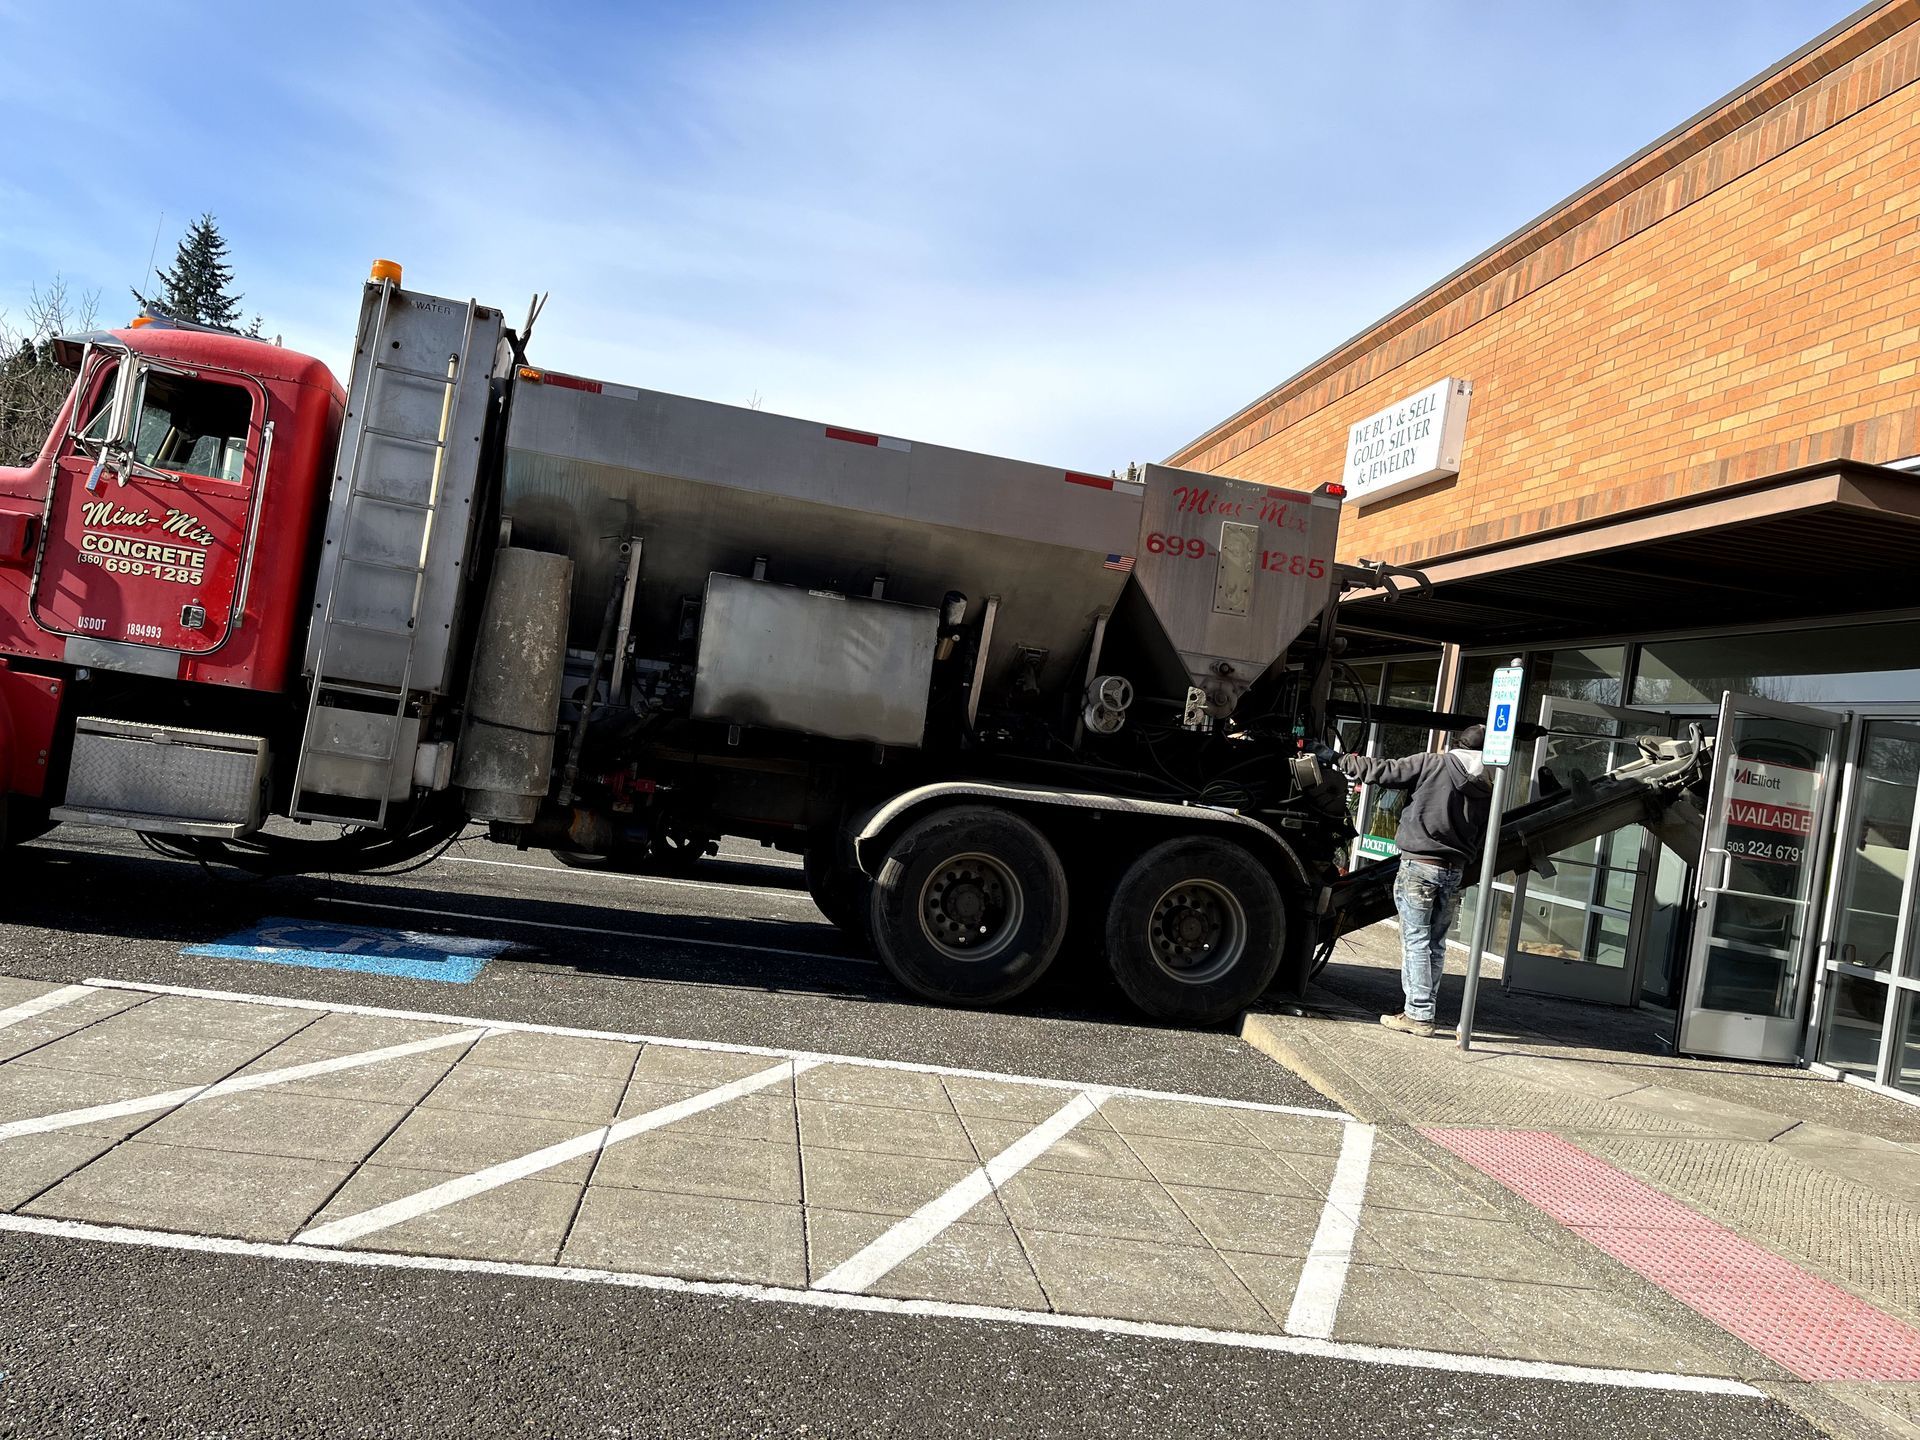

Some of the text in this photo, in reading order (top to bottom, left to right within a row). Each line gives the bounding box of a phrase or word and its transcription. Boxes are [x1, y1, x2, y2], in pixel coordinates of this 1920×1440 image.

[415, 301, 451, 315] WATER
[1355, 393, 1437, 445] WE BUY & SELL
[1353, 418, 1431, 467] GOLD, SILVER
[1357, 446, 1419, 486] & JEWELRY
[82, 501, 215, 546] Mini-Mix
[1173, 486, 1308, 534] Mini-Mix
[81, 534, 207, 568] CONCRETE
[1259, 550, 1325, 579] 1285
[77, 553, 203, 586] (360) 699-1285
[77, 615, 162, 639] USDOT 1894993
[1494, 690, 1517, 701] PARKING
[1751, 773, 1781, 790] Elliott
[1723, 802, 1812, 833] AVAILABLE
[1362, 837, 1387, 853] POCKET
[1727, 840, 1805, 863] 503 224 6791
